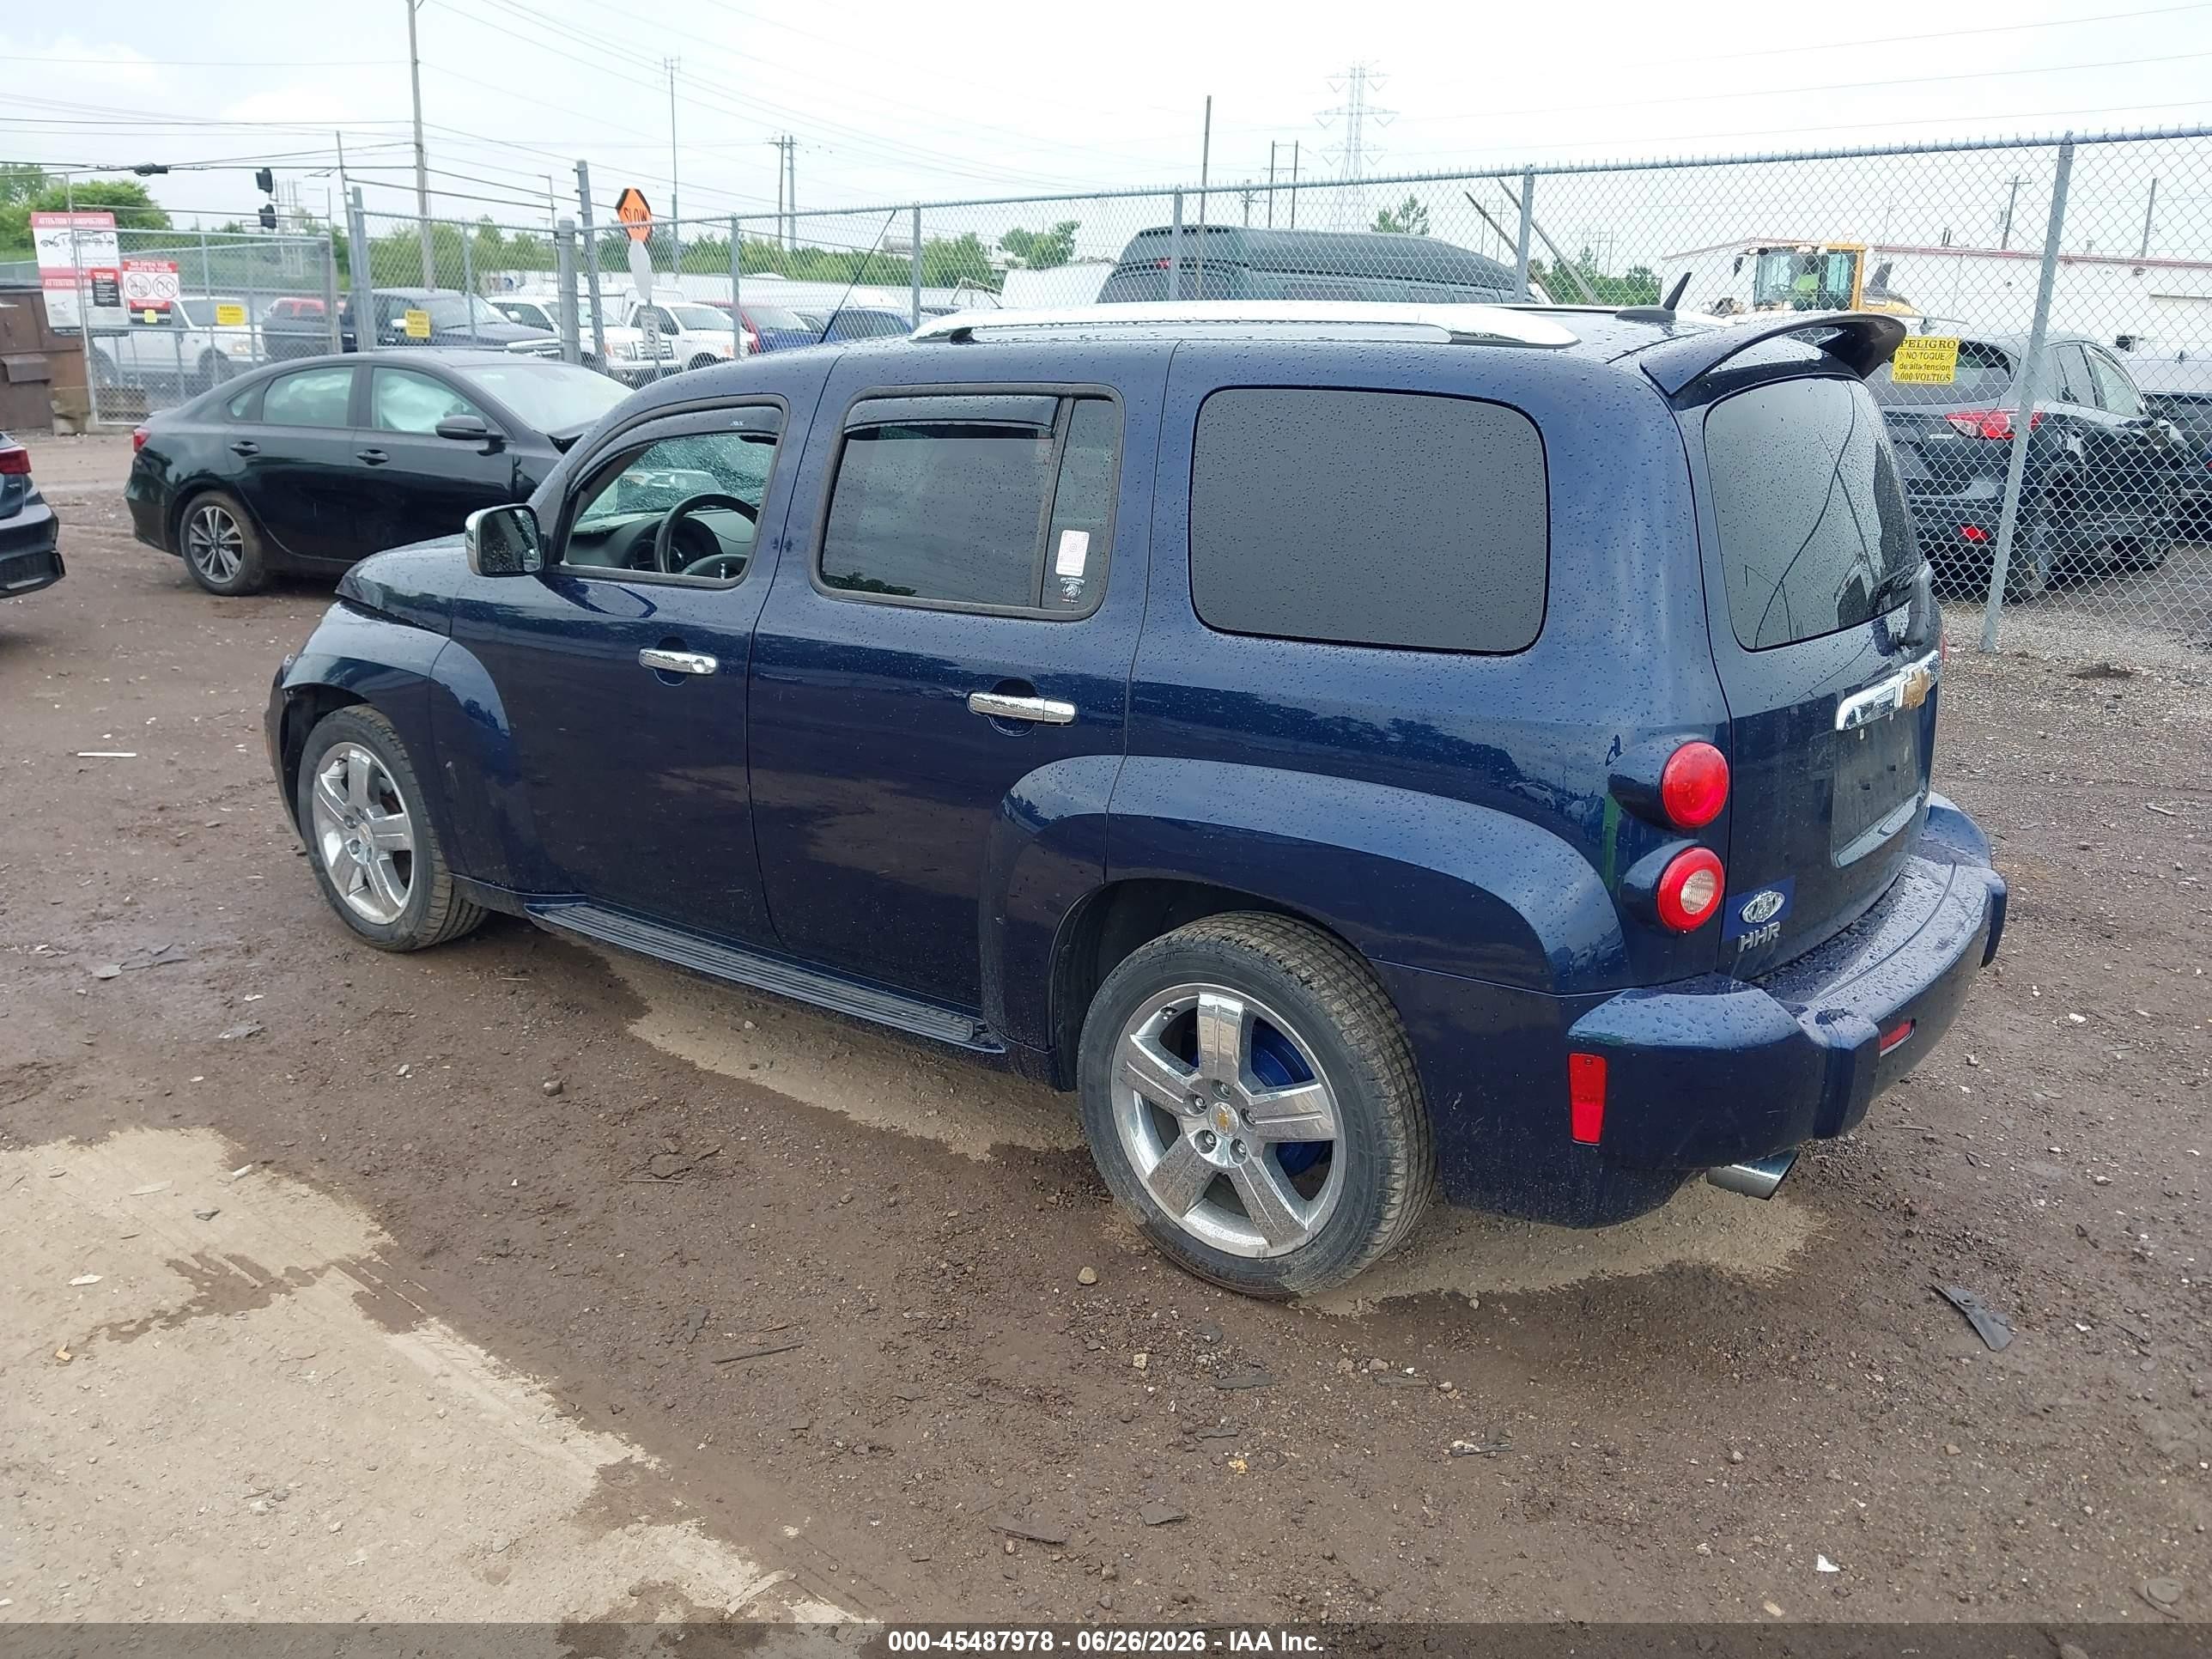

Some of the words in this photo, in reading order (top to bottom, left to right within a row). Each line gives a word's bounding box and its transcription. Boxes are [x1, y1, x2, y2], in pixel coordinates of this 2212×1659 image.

[623, 207, 647, 230] SLOW
[46, 278, 76, 287] ATTENTION
[647, 330, 656, 344] 5
[1900, 339, 1956, 349] PELIGRO
[1919, 352, 1945, 361] TOQUE
[1738, 921, 1781, 953] HHR
